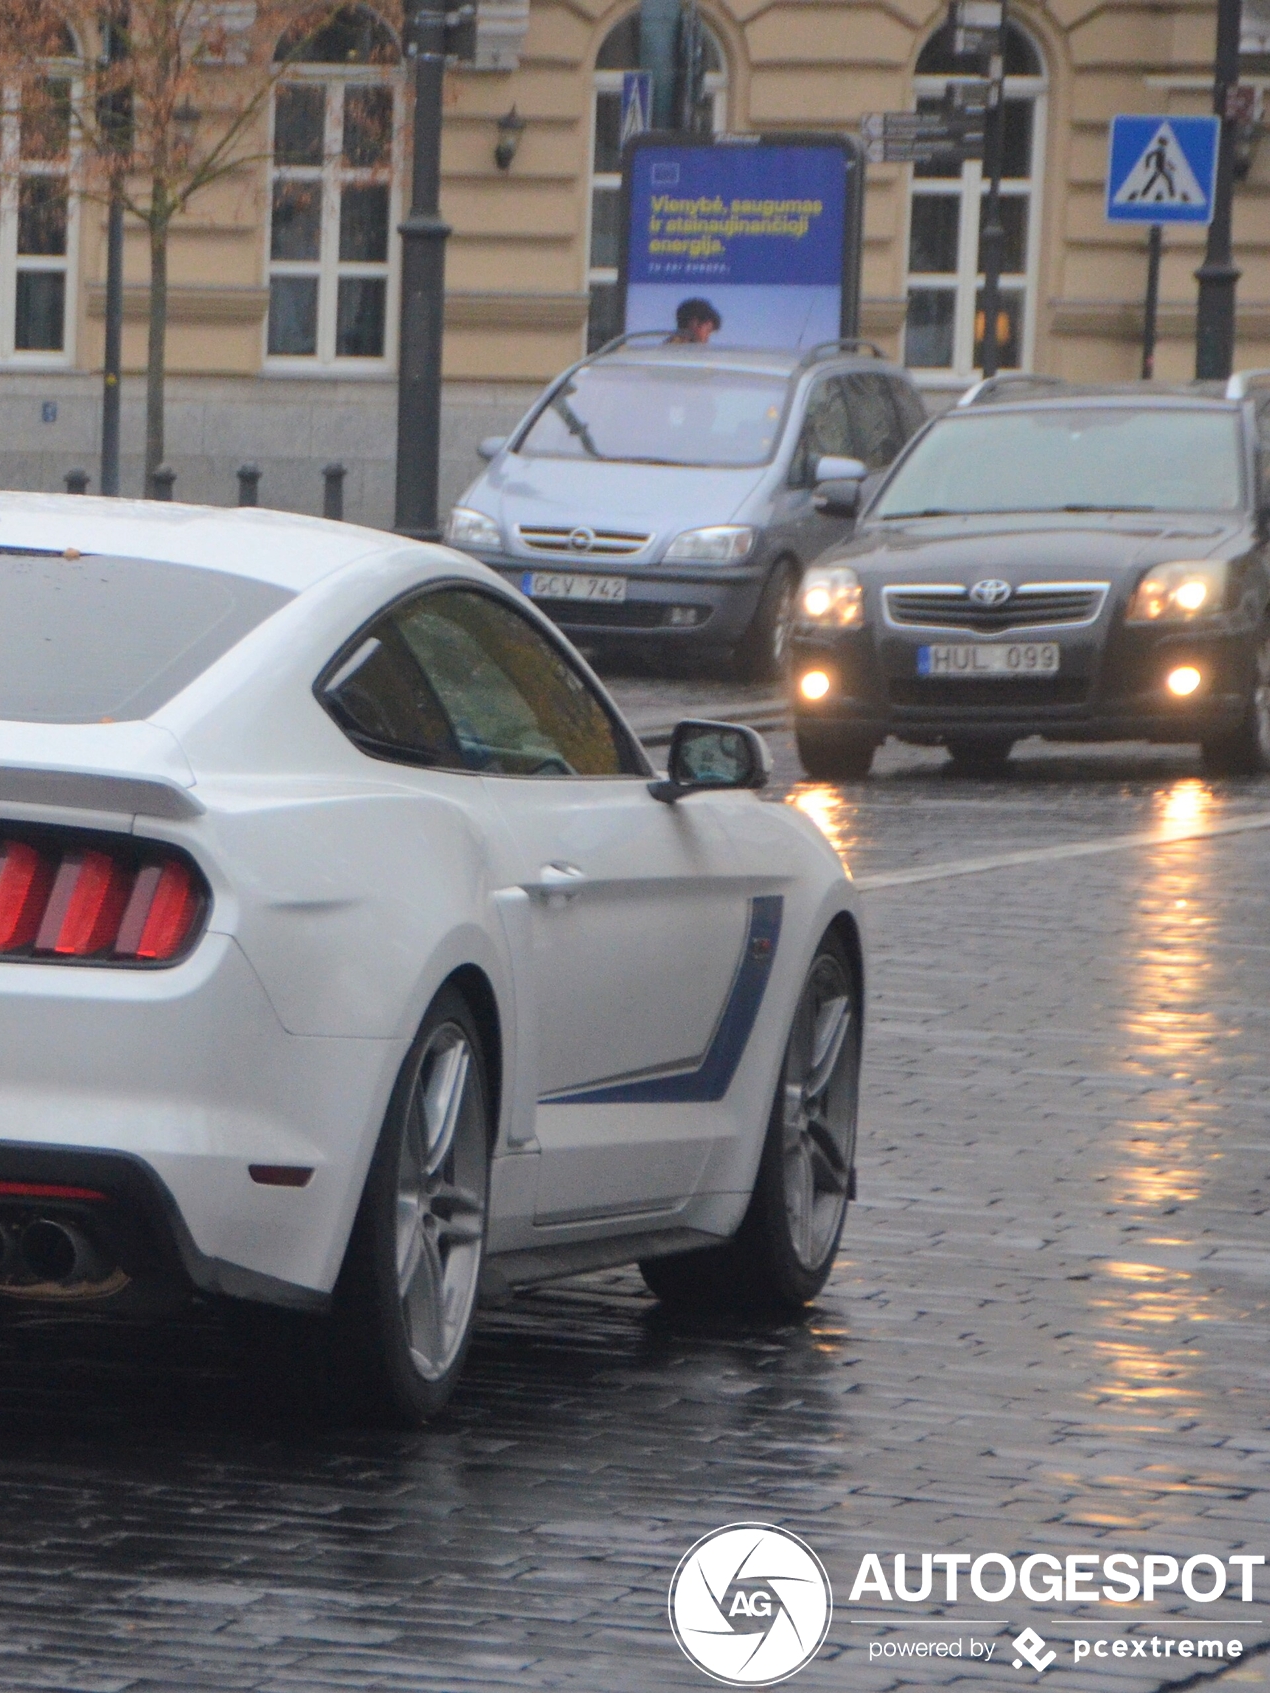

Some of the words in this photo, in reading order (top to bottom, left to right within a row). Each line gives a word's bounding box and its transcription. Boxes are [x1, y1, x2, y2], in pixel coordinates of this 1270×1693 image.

[731, 199, 824, 217] saugumas
[648, 215, 662, 234] ir
[648, 235, 727, 258] energija.
[534, 576, 575, 594] GCV
[588, 579, 624, 598] 742
[933, 646, 989, 670] HUL
[1006, 646, 1055, 669] 099
